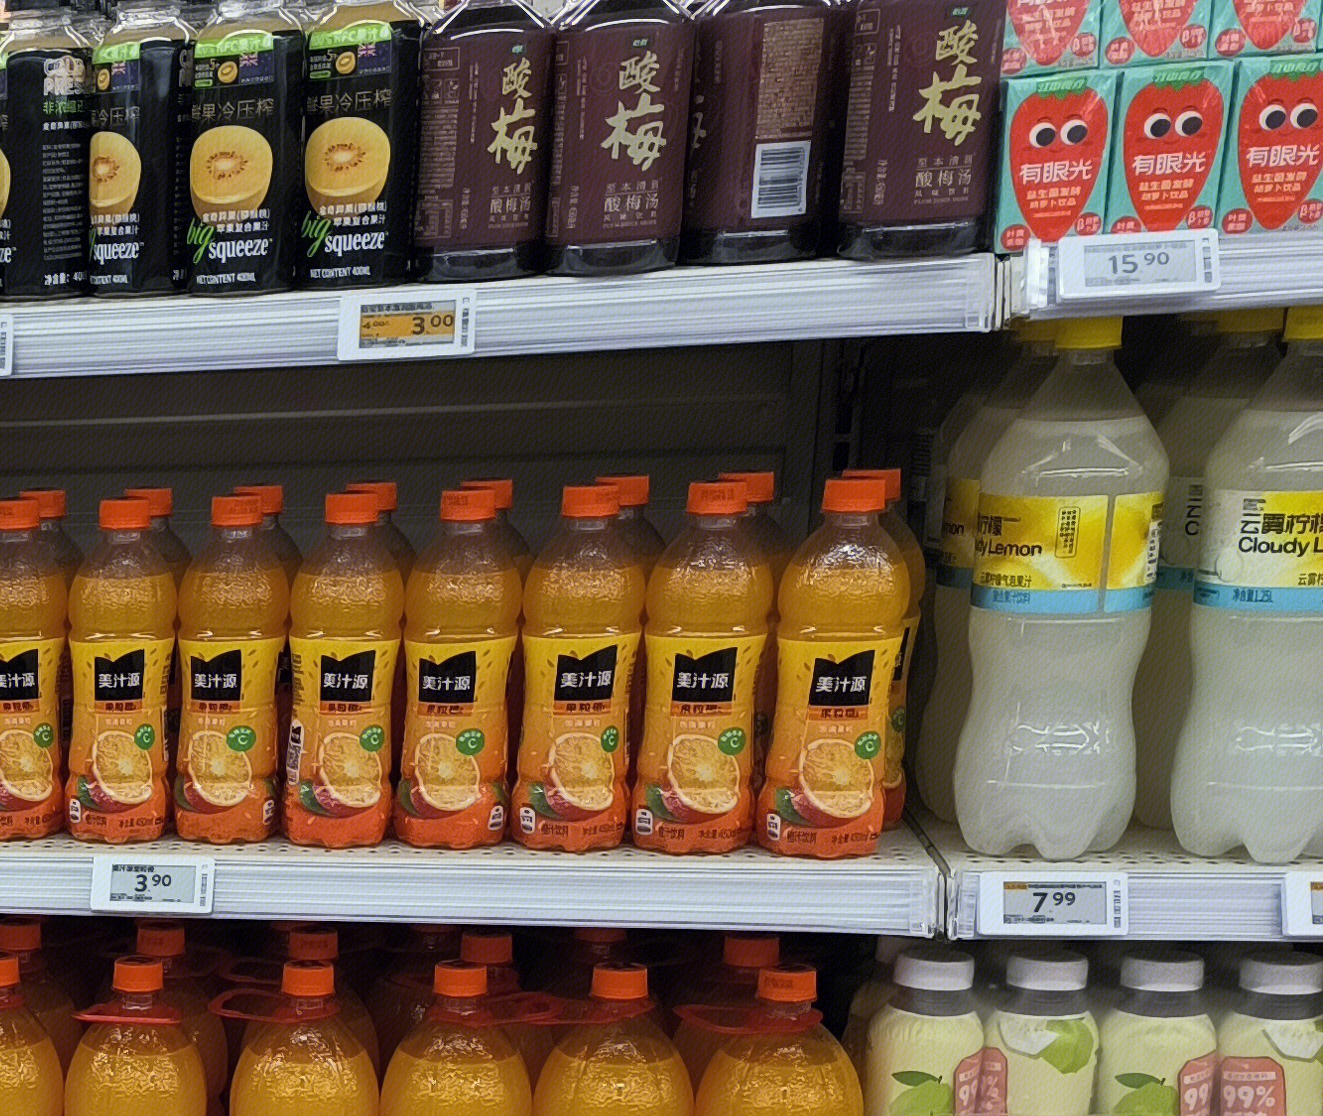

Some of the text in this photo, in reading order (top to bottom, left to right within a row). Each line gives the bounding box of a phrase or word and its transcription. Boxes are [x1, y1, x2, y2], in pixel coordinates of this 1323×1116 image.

[912, 18, 982, 146] 酸梅
[488, 57, 537, 174] 酸梅
[602, 50, 667, 172] 酸梅
[1132, 151, 1206, 177] 有眼光
[1245, 144, 1321, 169] 有眼光
[1019, 159, 1093, 185] 有眼光
[208, 237, 269, 260] squeeze
[324, 231, 386, 256] squeeze
[1108, 251, 1170, 275] 15.90
[412, 315, 455, 336] 3.00
[988, 542, 1042, 558] Lemon
[1238, 536, 1309, 558] Cloudy
[98, 671, 141, 688] 美汁源
[193, 672, 238, 689] 美汁源
[323, 672, 369, 689] 美汁源
[422, 674, 471, 692] 美汁源
[561, 670, 613, 689] 美汁源
[676, 671, 730, 690] 美汁源
[815, 675, 867, 694] 美汁源
[134, 872, 172, 894] 3.90
[1031, 891, 1076, 914] 7.99
[1223, 1085, 1276, 1109] 99%
